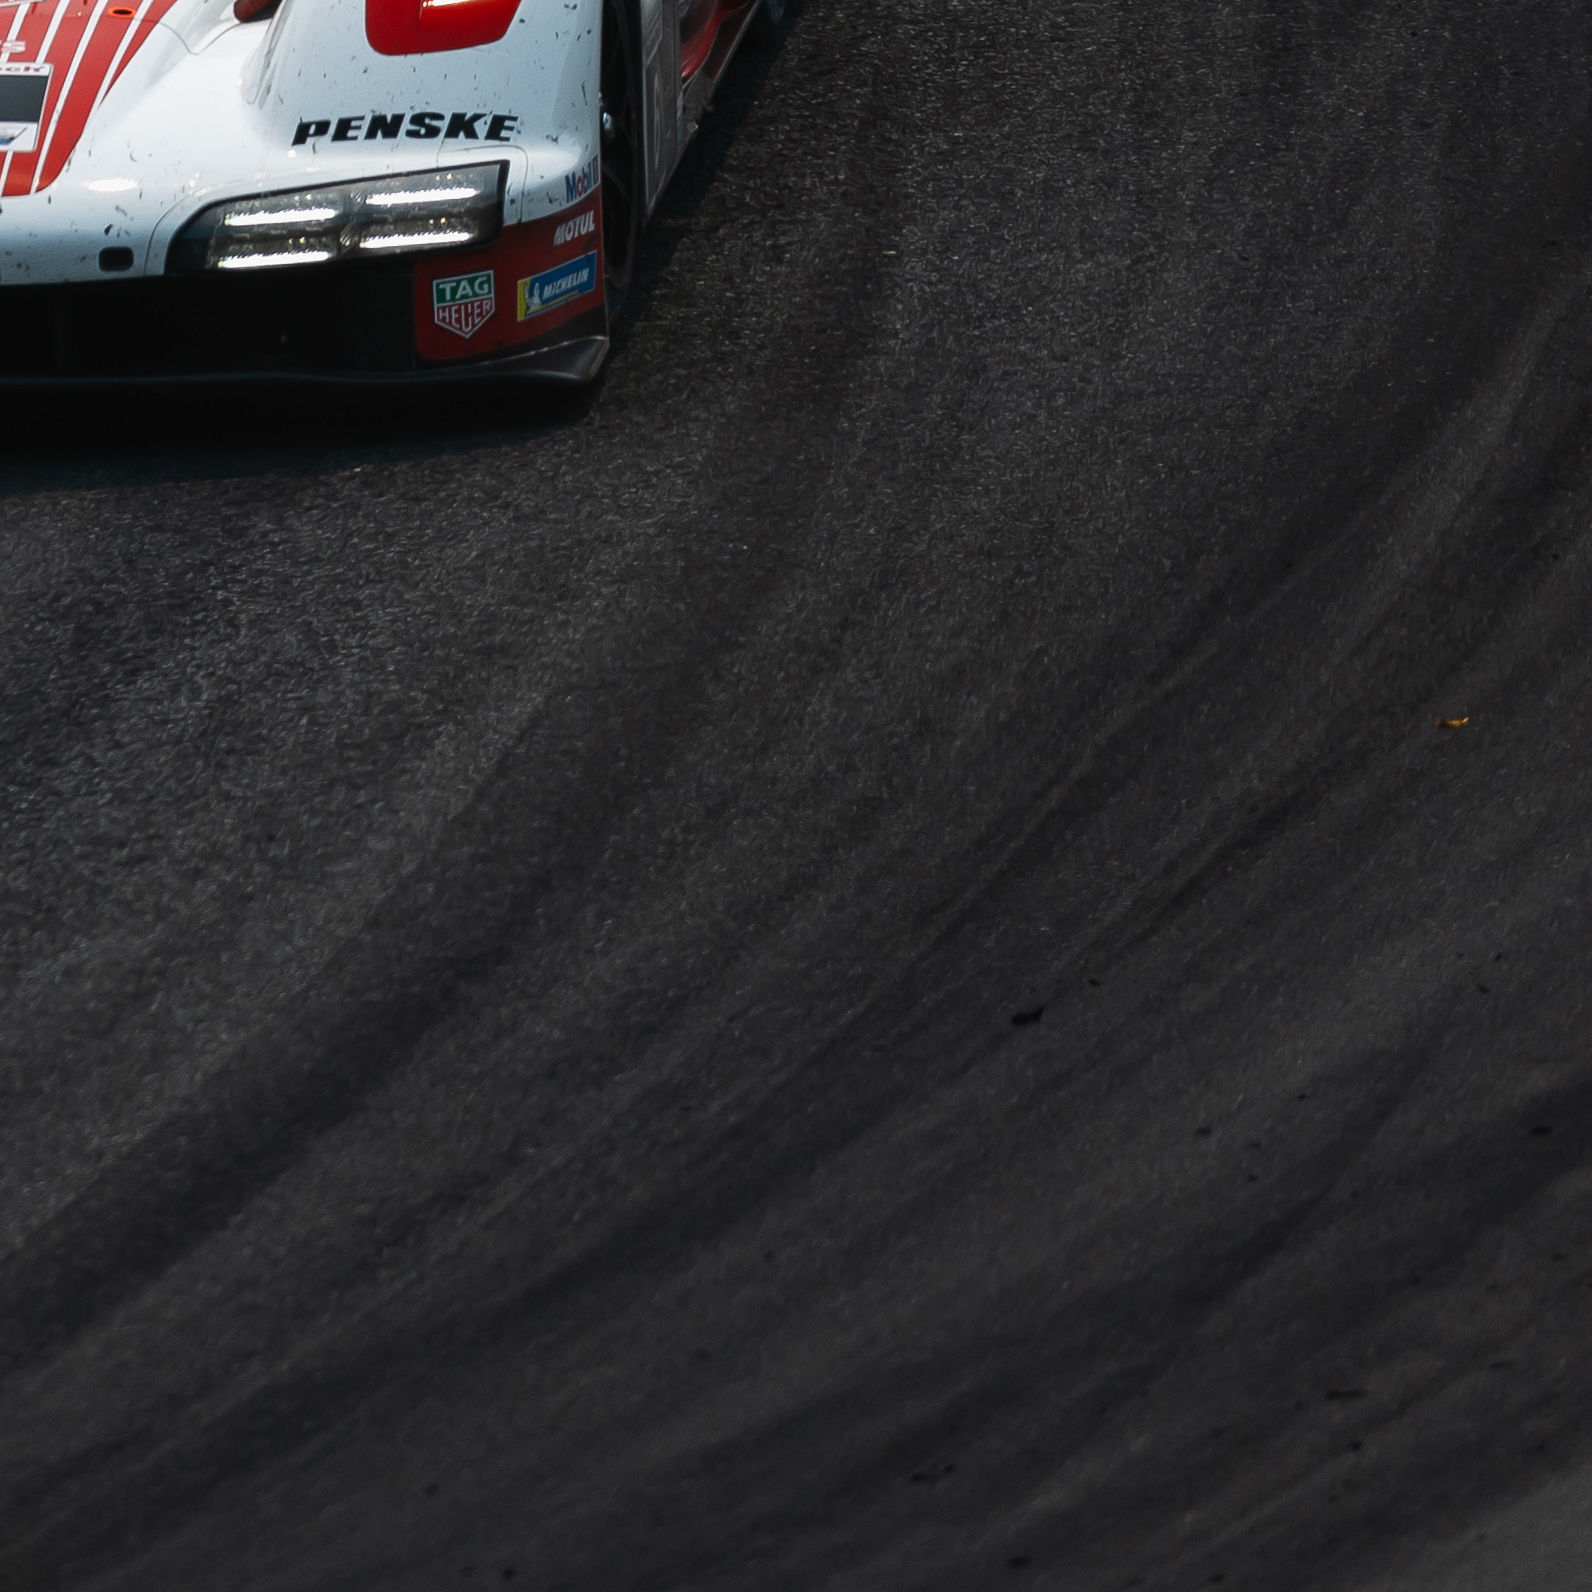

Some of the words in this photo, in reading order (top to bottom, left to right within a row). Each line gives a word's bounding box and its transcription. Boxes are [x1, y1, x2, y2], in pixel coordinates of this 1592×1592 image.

[291, 111, 519, 147] PENSKE
[553, 210, 596, 246] MOTUL
[438, 276, 489, 302] TAG
[542, 267, 590, 300] MICHELIN
[438, 300, 492, 333] HEUER
